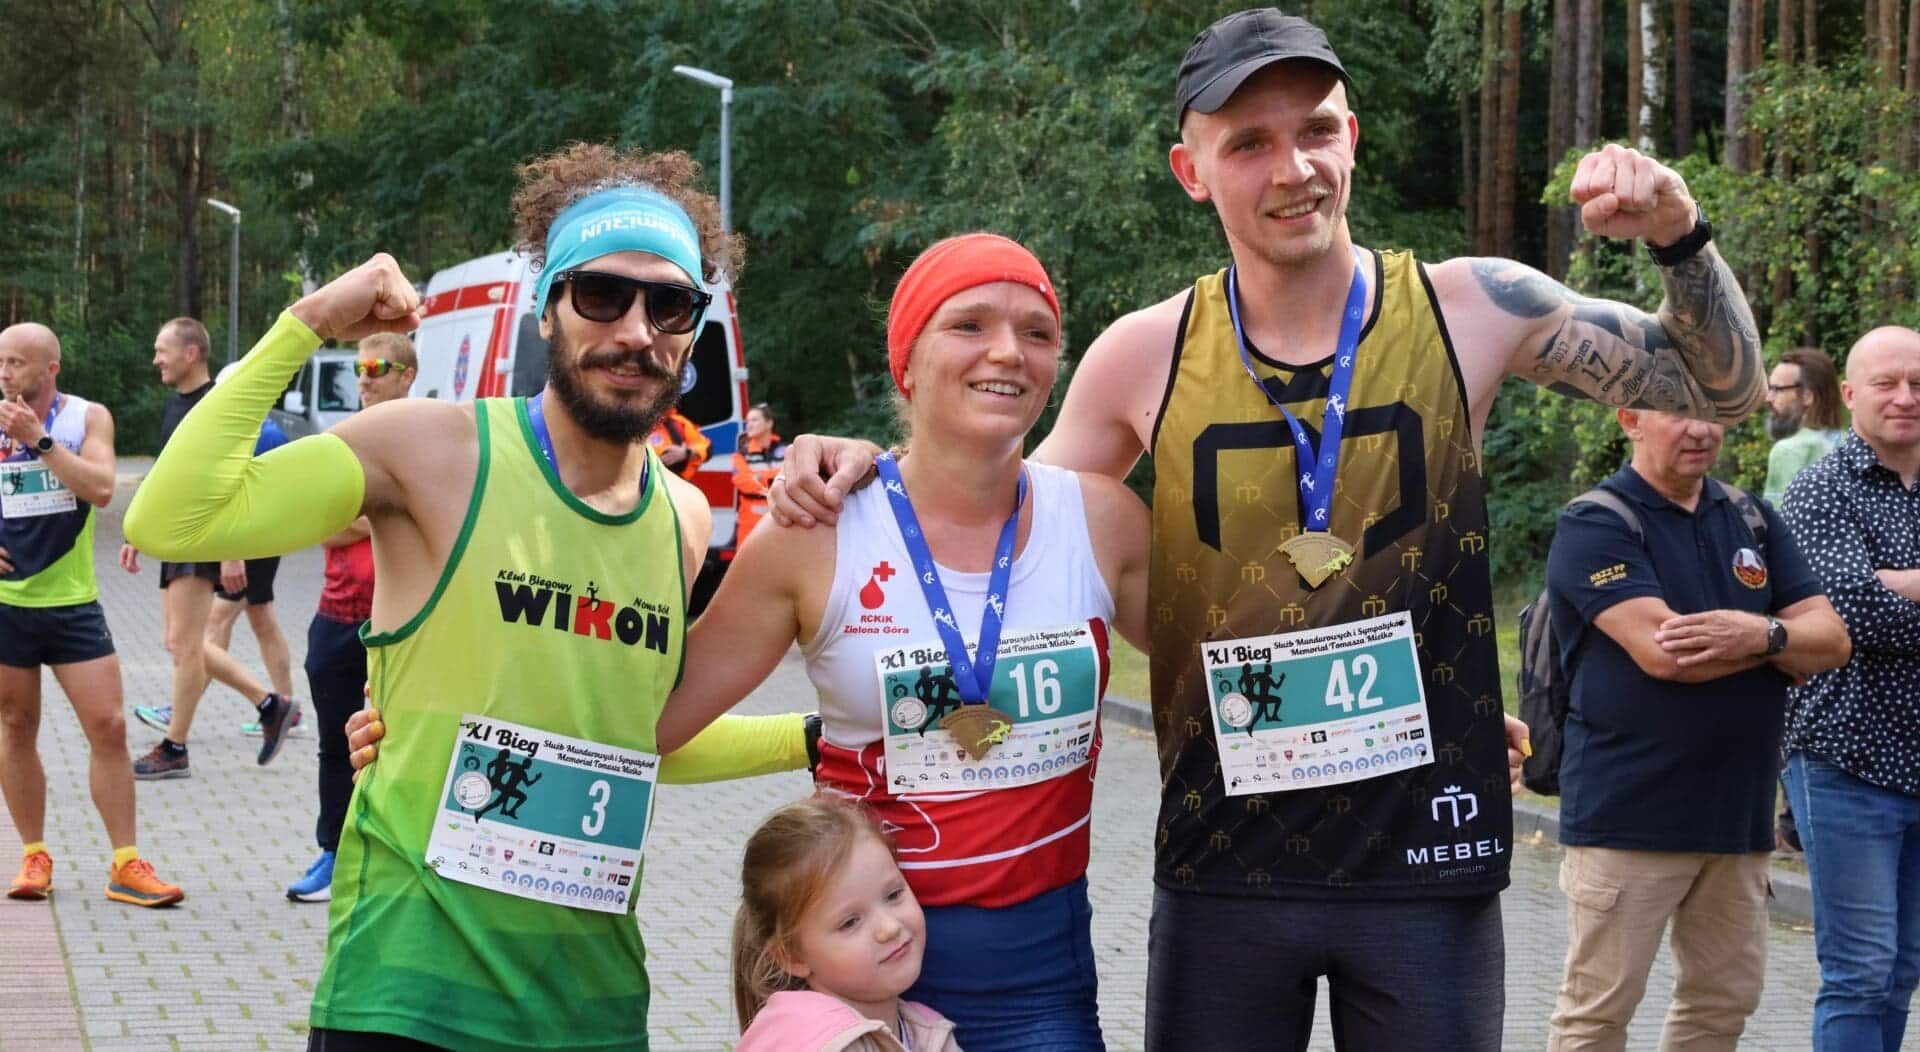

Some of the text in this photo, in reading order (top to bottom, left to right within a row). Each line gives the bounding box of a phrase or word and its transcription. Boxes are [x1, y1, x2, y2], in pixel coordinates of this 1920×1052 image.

[1581, 350, 1611, 383] 17
[498, 569, 572, 592] Klub Biegowy
[633, 597, 656, 612] Nowa
[495, 581, 670, 655] WIKON
[861, 615, 893, 623] RCKiK
[844, 624, 909, 634] Zielona Góra
[1294, 631, 1352, 648] Mundurowych
[1012, 641, 1048, 655] Tomasza
[1207, 645, 1272, 664] XI Bieg
[1328, 637, 1364, 652] Tomasza
[881, 650, 906, 671] XI
[1008, 658, 1062, 718] 16
[1324, 653, 1384, 713] 42
[466, 723, 540, 757] XI Bieg
[581, 779, 611, 837] 3
[1407, 838, 1504, 865] MEBEL
[1440, 864, 1485, 878] premium
